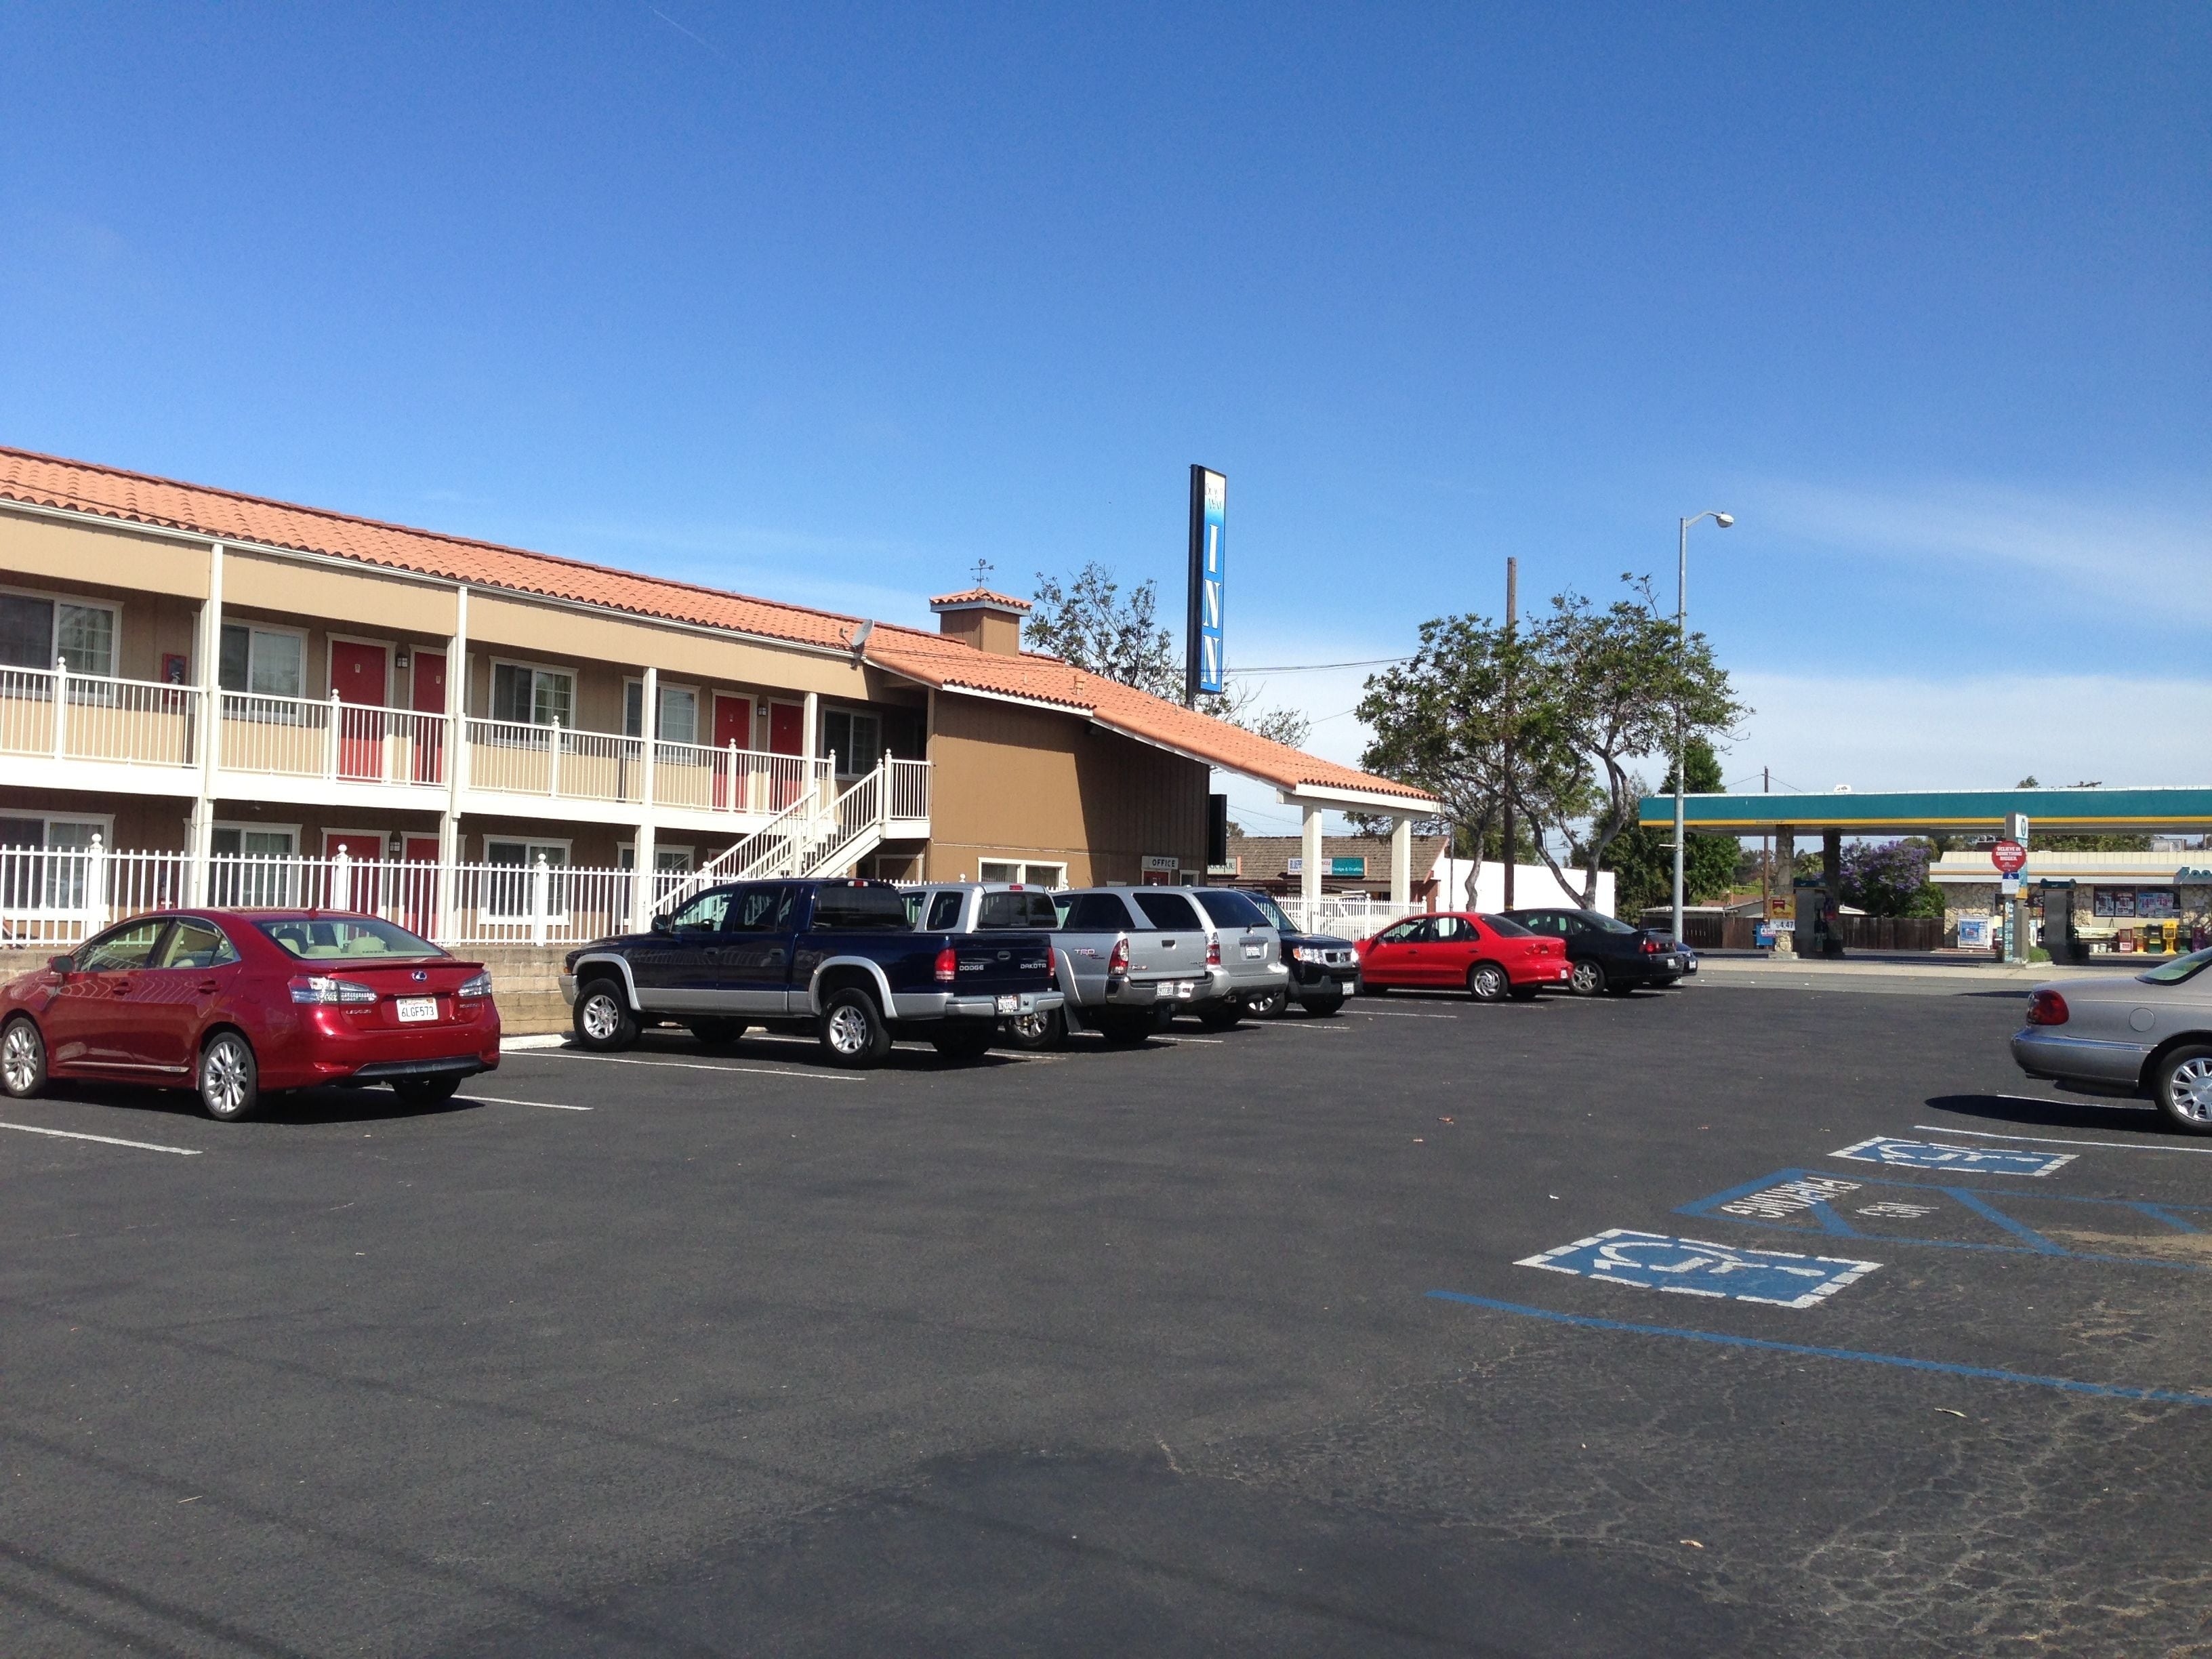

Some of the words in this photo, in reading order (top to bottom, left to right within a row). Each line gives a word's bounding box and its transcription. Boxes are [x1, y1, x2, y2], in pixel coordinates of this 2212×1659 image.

[1202, 524, 1221, 684] INN
[1152, 859, 1175, 867] OFFICE
[401, 1006, 434, 1017] 6LGF573
